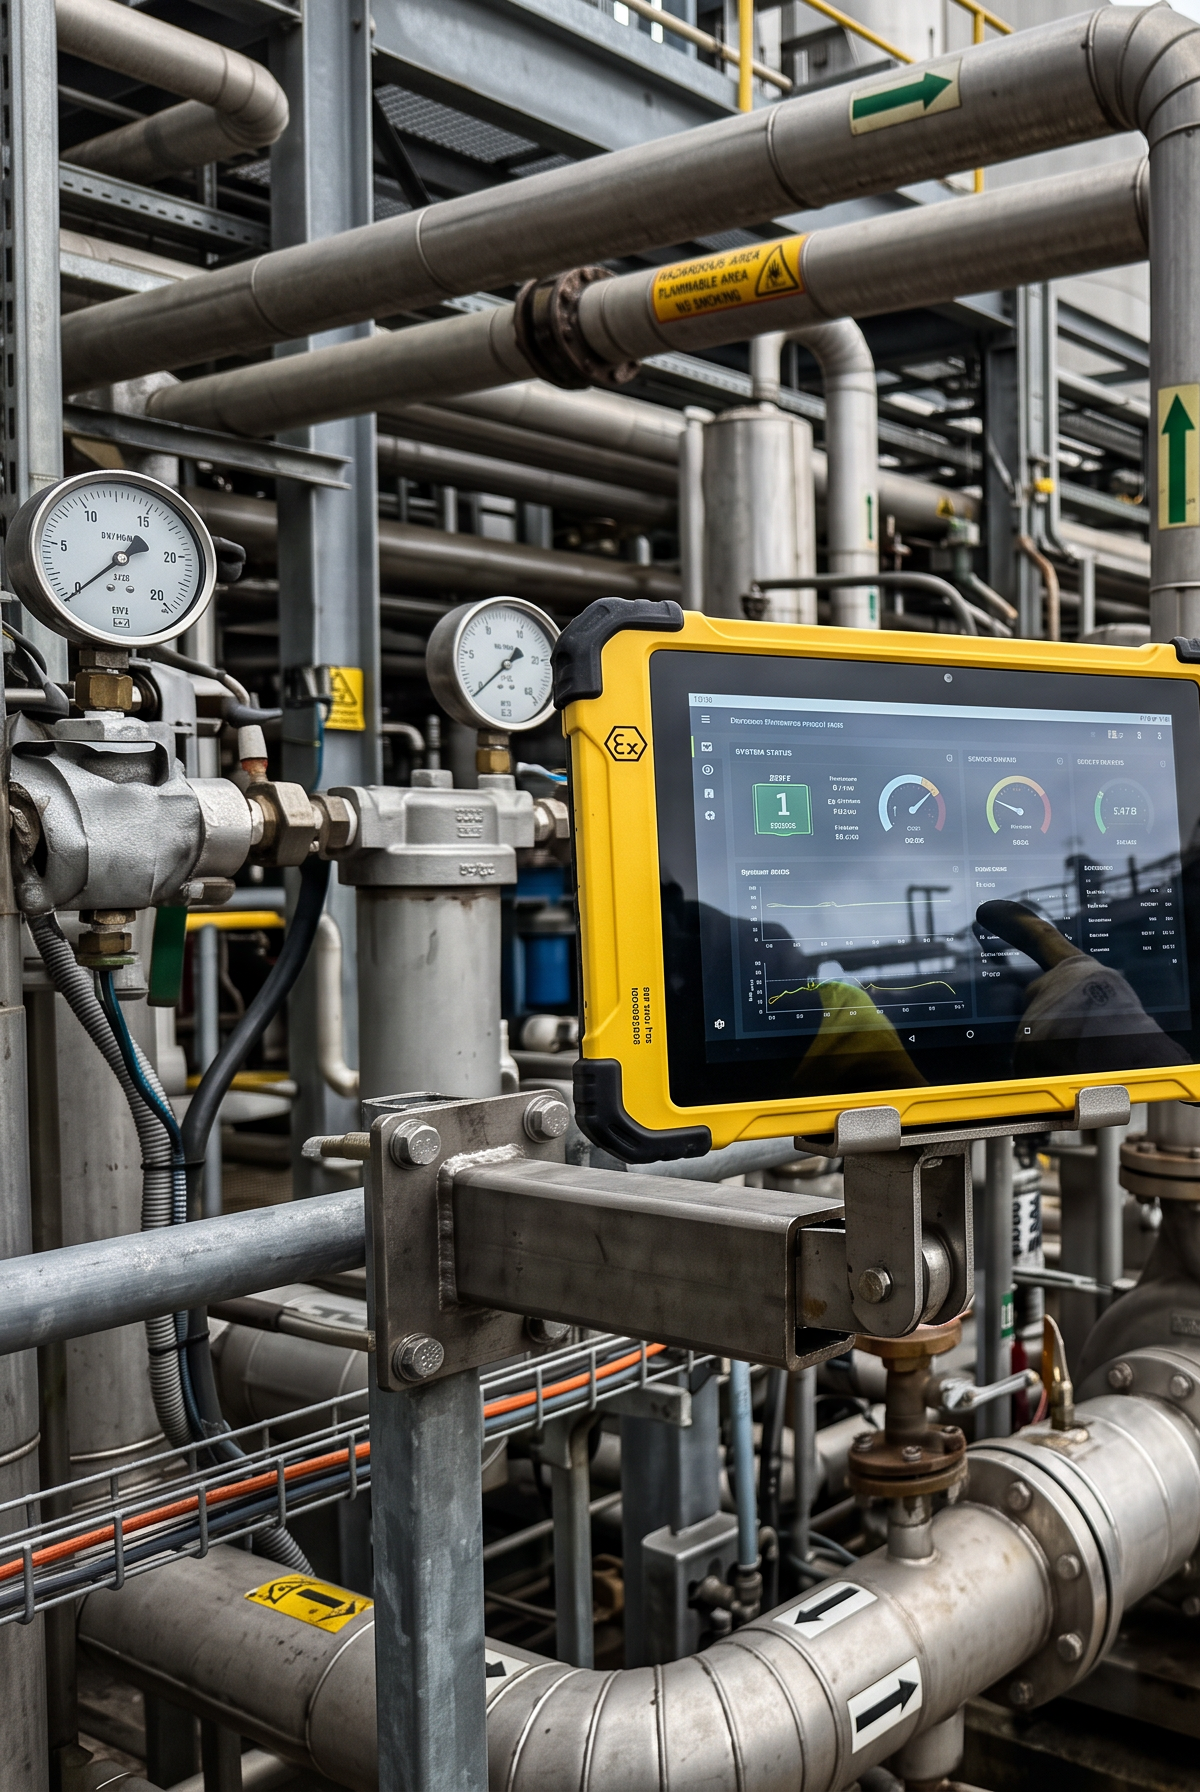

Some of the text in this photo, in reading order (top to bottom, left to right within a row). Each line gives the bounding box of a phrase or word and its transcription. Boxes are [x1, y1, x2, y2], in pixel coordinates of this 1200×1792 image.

[720, 269, 749, 286] AREA
[84, 510, 98, 523] 10
[137, 516, 150, 528] 15
[60, 540, 68, 552] 5
[163, 551, 177, 564] 20
[150, 589, 164, 601] 20
[613, 733, 639, 755] Ex
[776, 792, 791, 816] 1
